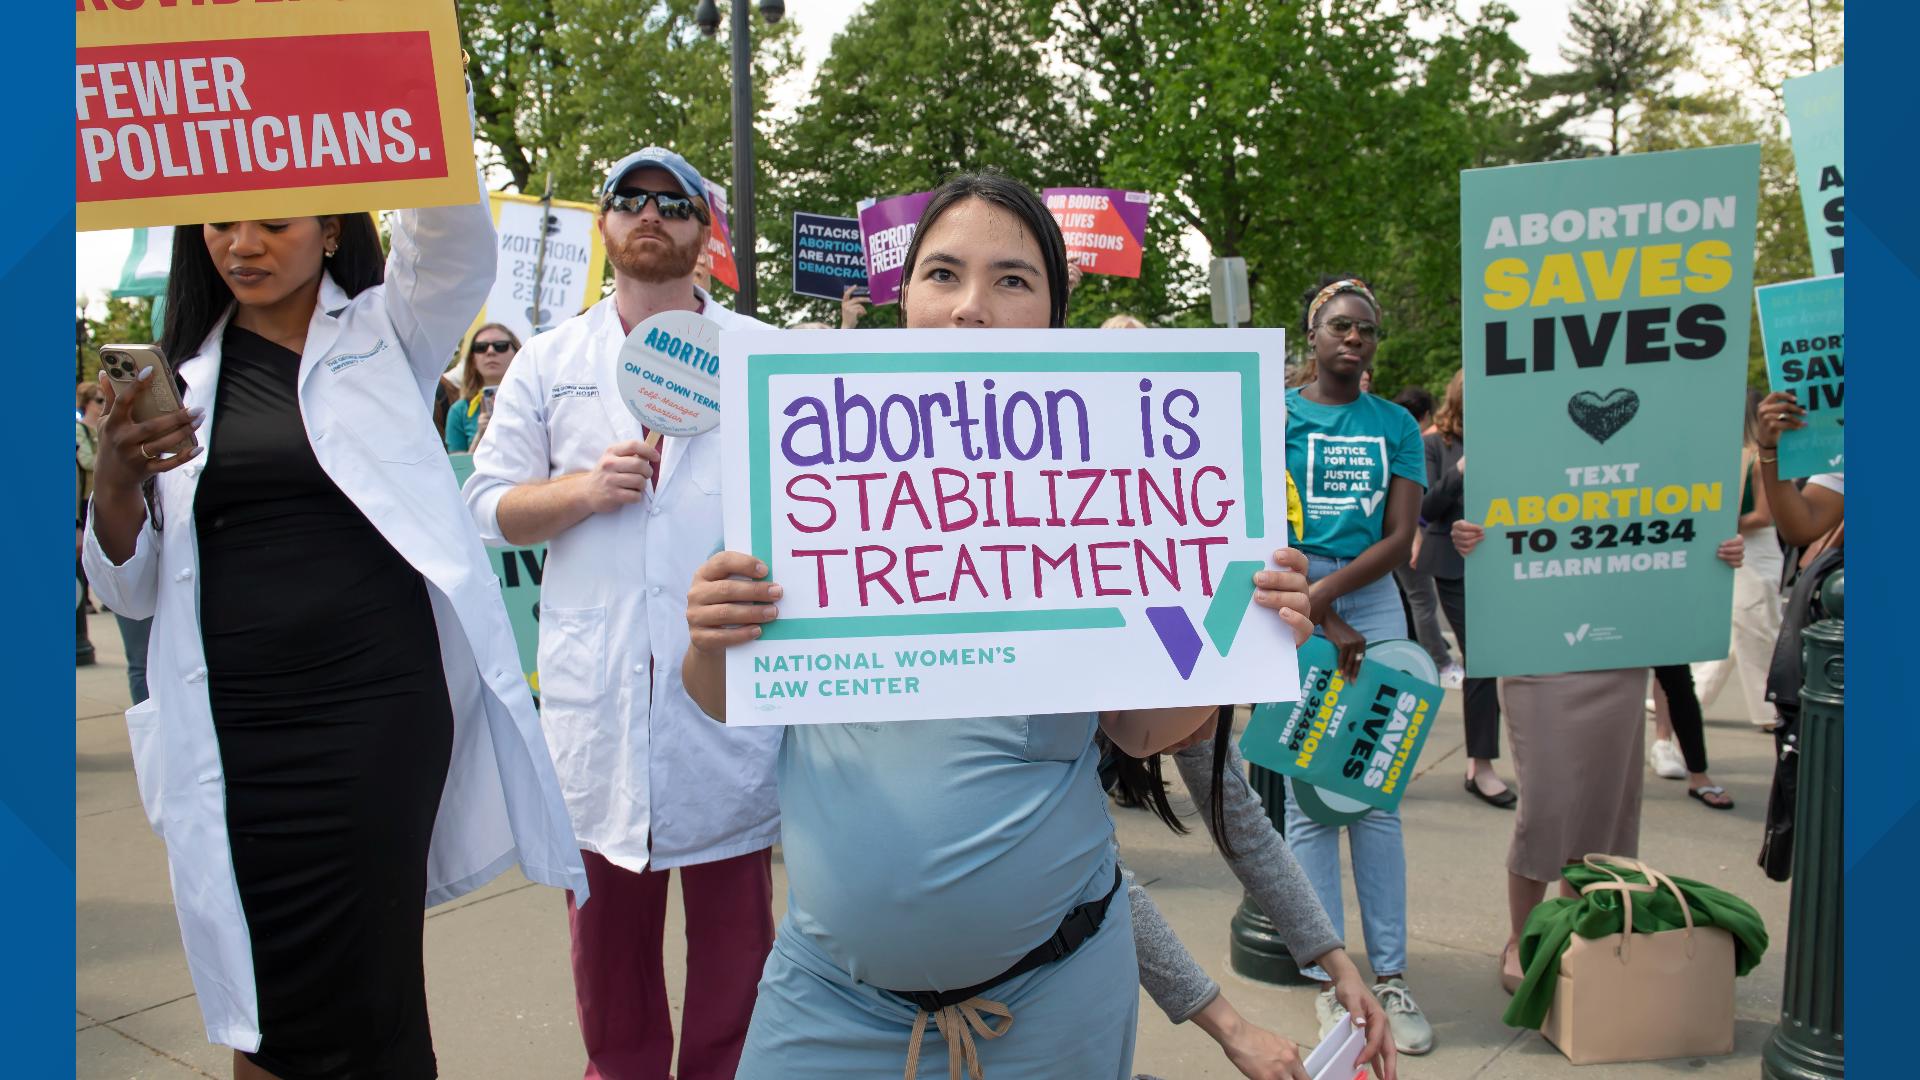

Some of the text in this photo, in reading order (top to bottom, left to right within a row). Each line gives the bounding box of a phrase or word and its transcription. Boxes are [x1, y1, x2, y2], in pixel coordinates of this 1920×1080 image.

[76, 56, 252, 120] FEWER
[80, 108, 432, 183] POLITICIANS.
[1065, 213, 1095, 229] LIVES
[1068, 194, 1110, 211] BODIES
[799, 223, 859, 240] ATTACKS
[1483, 195, 1737, 250] ABORTION
[799, 249, 824, 262] ARE
[1483, 239, 1733, 312] SAVES
[644, 327, 720, 379] ABORTIO
[1485, 303, 1728, 376] LIVES
[1780, 334, 1844, 356] ABOR
[624, 362, 641, 375] ON
[642, 370, 664, 386] OUR
[666, 381, 691, 398] OWN
[780, 376, 1091, 467] abortion
[1139, 378, 1201, 461] is
[1323, 446, 1367, 455] JUSTICE
[1324, 456, 1375, 466] FOR HER.
[1323, 470, 1371, 480] JUSTICE
[1323, 481, 1347, 491] FOR
[1565, 463, 1640, 487] TEXT
[785, 465, 1236, 534] STABILIZING
[1483, 482, 1723, 528] ABORTION
[1506, 518, 1697, 556] TO 32434
[791, 536, 1230, 608] TREATMENT
[1513, 550, 1687, 581] LEARN MORE
[754, 646, 1016, 673] NATIONAL WOMEN'S
[754, 676, 920, 699] LAW CENTER
[1278, 707, 1302, 745] MORE
[1288, 668, 1333, 751] TO 32434
[1327, 704, 1348, 738] TEXT
[1342, 683, 1398, 780] LIVES
[1363, 691, 1417, 789] SAVES
[1381, 697, 1430, 794] ABORTION
